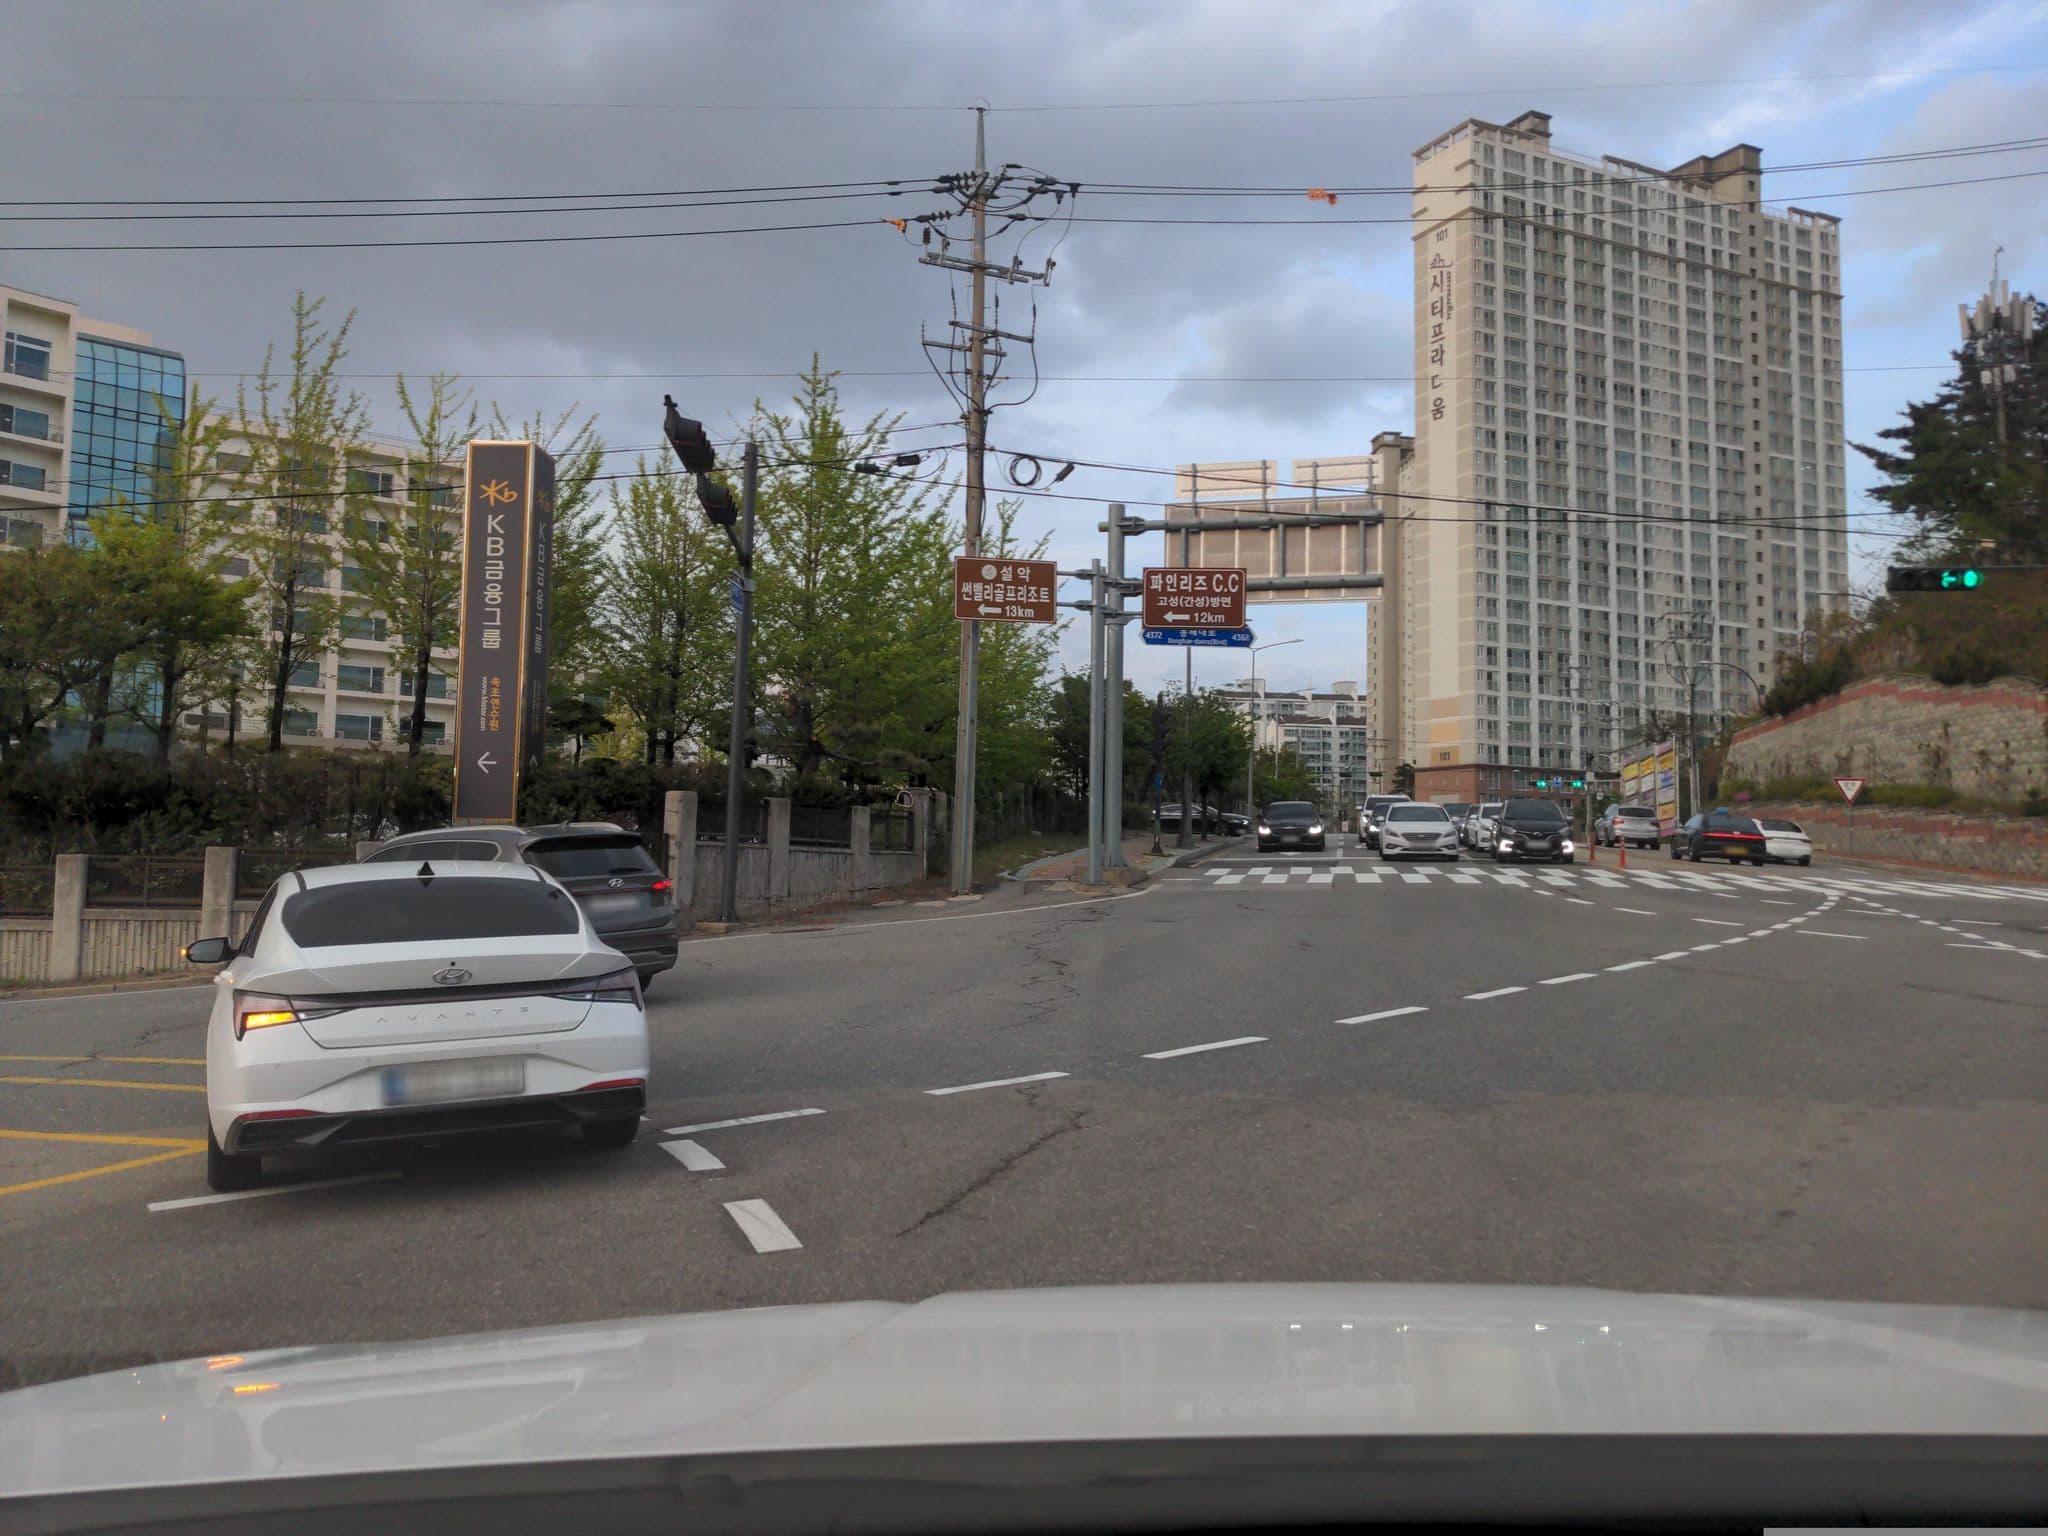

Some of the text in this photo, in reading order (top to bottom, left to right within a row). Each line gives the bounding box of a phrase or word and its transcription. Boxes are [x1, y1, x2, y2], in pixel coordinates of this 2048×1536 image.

[1436, 228, 1448, 242] 101
[481, 514, 505, 649] KB금융그룹
[1150, 573, 1239, 592] 파인리즈 C.C
[961, 581, 1050, 603] 썬밸리골프리조트
[1156, 595, 1232, 607] 고성(간성)방면
[1005, 605, 1034, 618] 13km
[1193, 612, 1225, 623] 12km
[1439, 751, 1451, 761] 101
[376, 1006, 529, 1024] AVANTE
